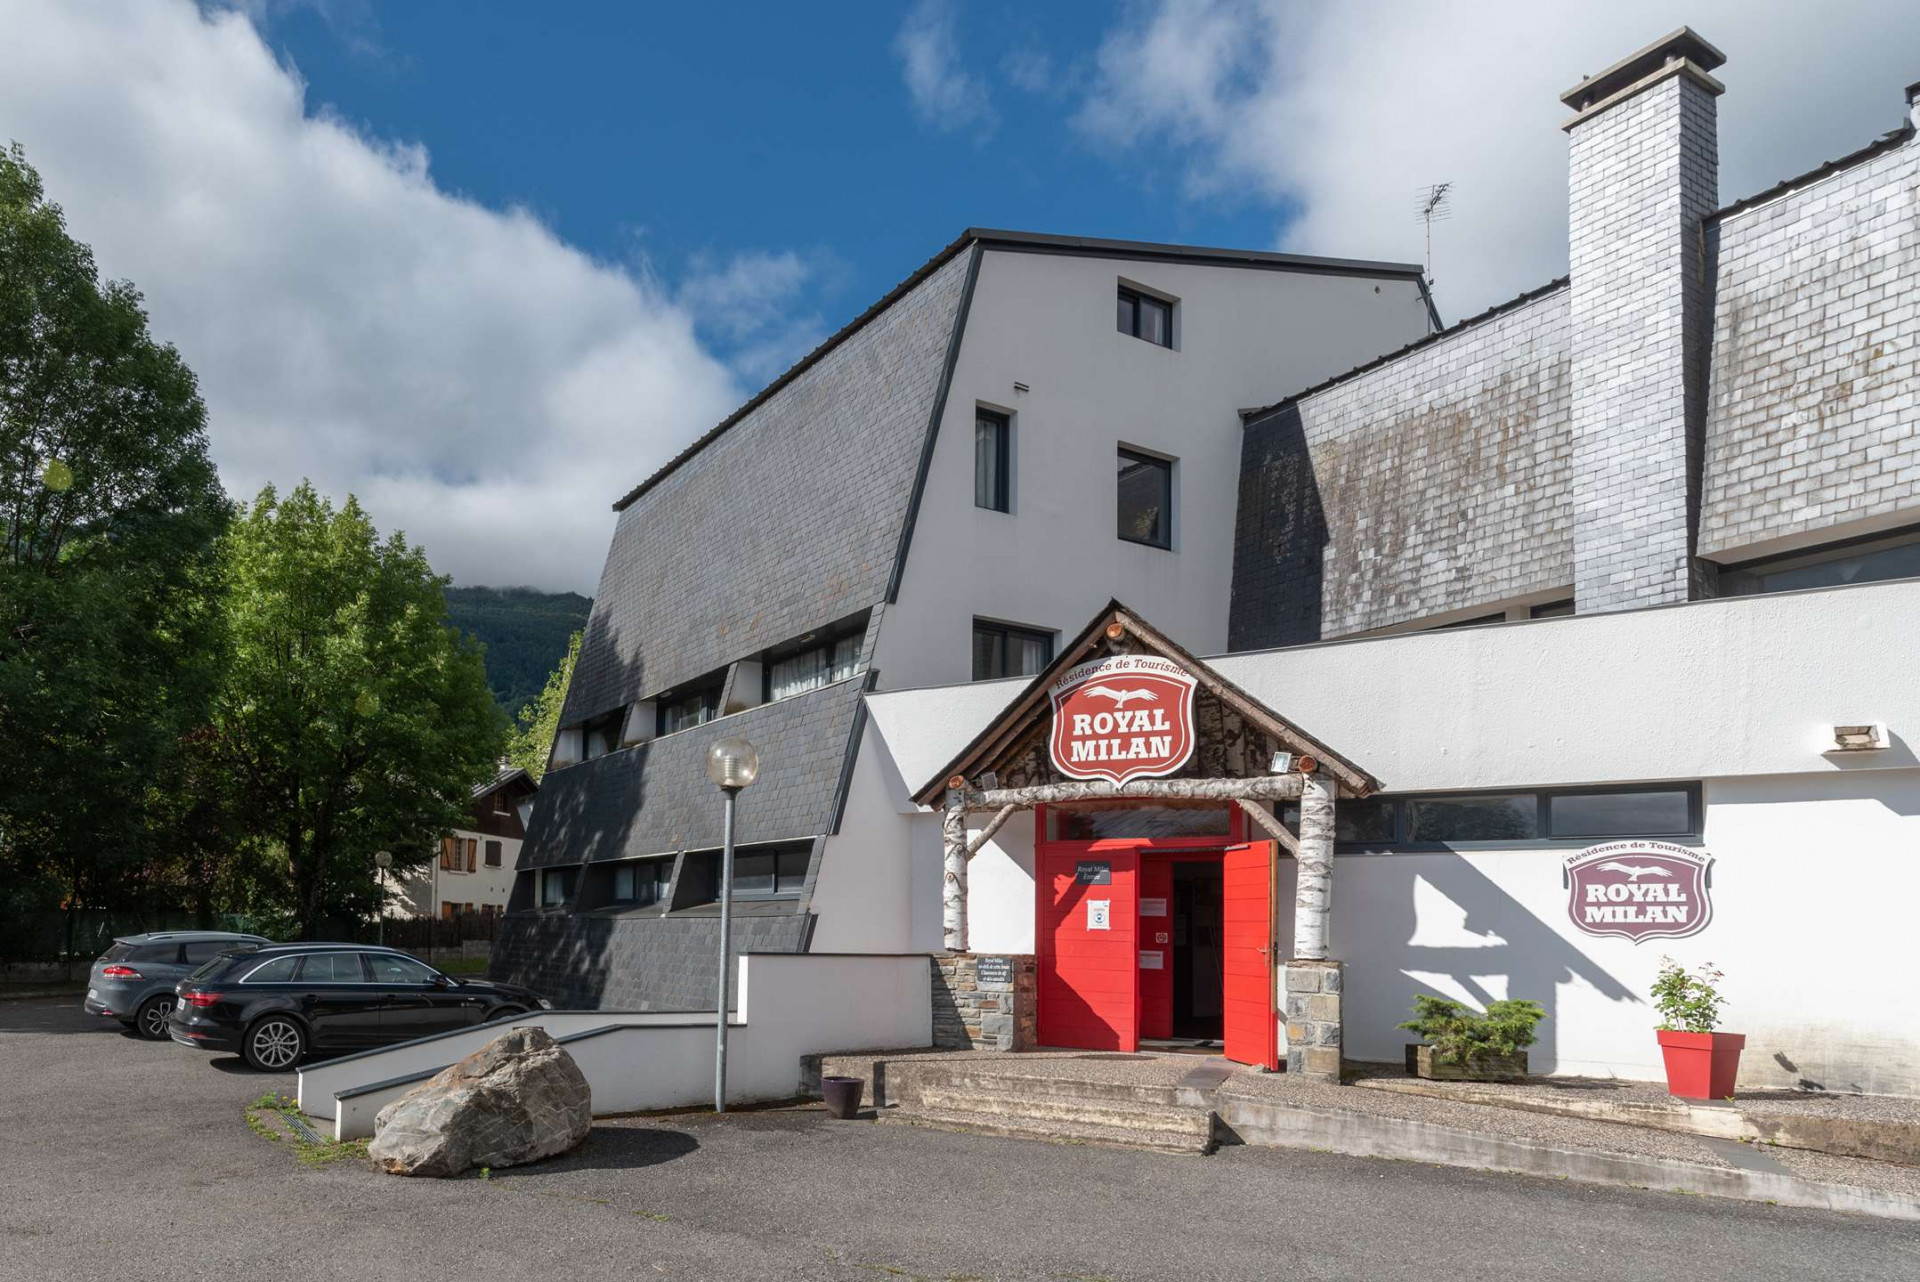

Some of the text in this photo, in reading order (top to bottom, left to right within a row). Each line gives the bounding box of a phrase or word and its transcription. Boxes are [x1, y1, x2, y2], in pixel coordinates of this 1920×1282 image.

[1055, 658, 1188, 689] Résidence de Tourisme
[1072, 708, 1170, 736] ROYAL
[1070, 735, 1172, 762] MILAN
[1566, 841, 1706, 865] Résidence de Tourisme
[1585, 883, 1687, 903] ROYAL
[1584, 905, 1689, 923] MILAN
